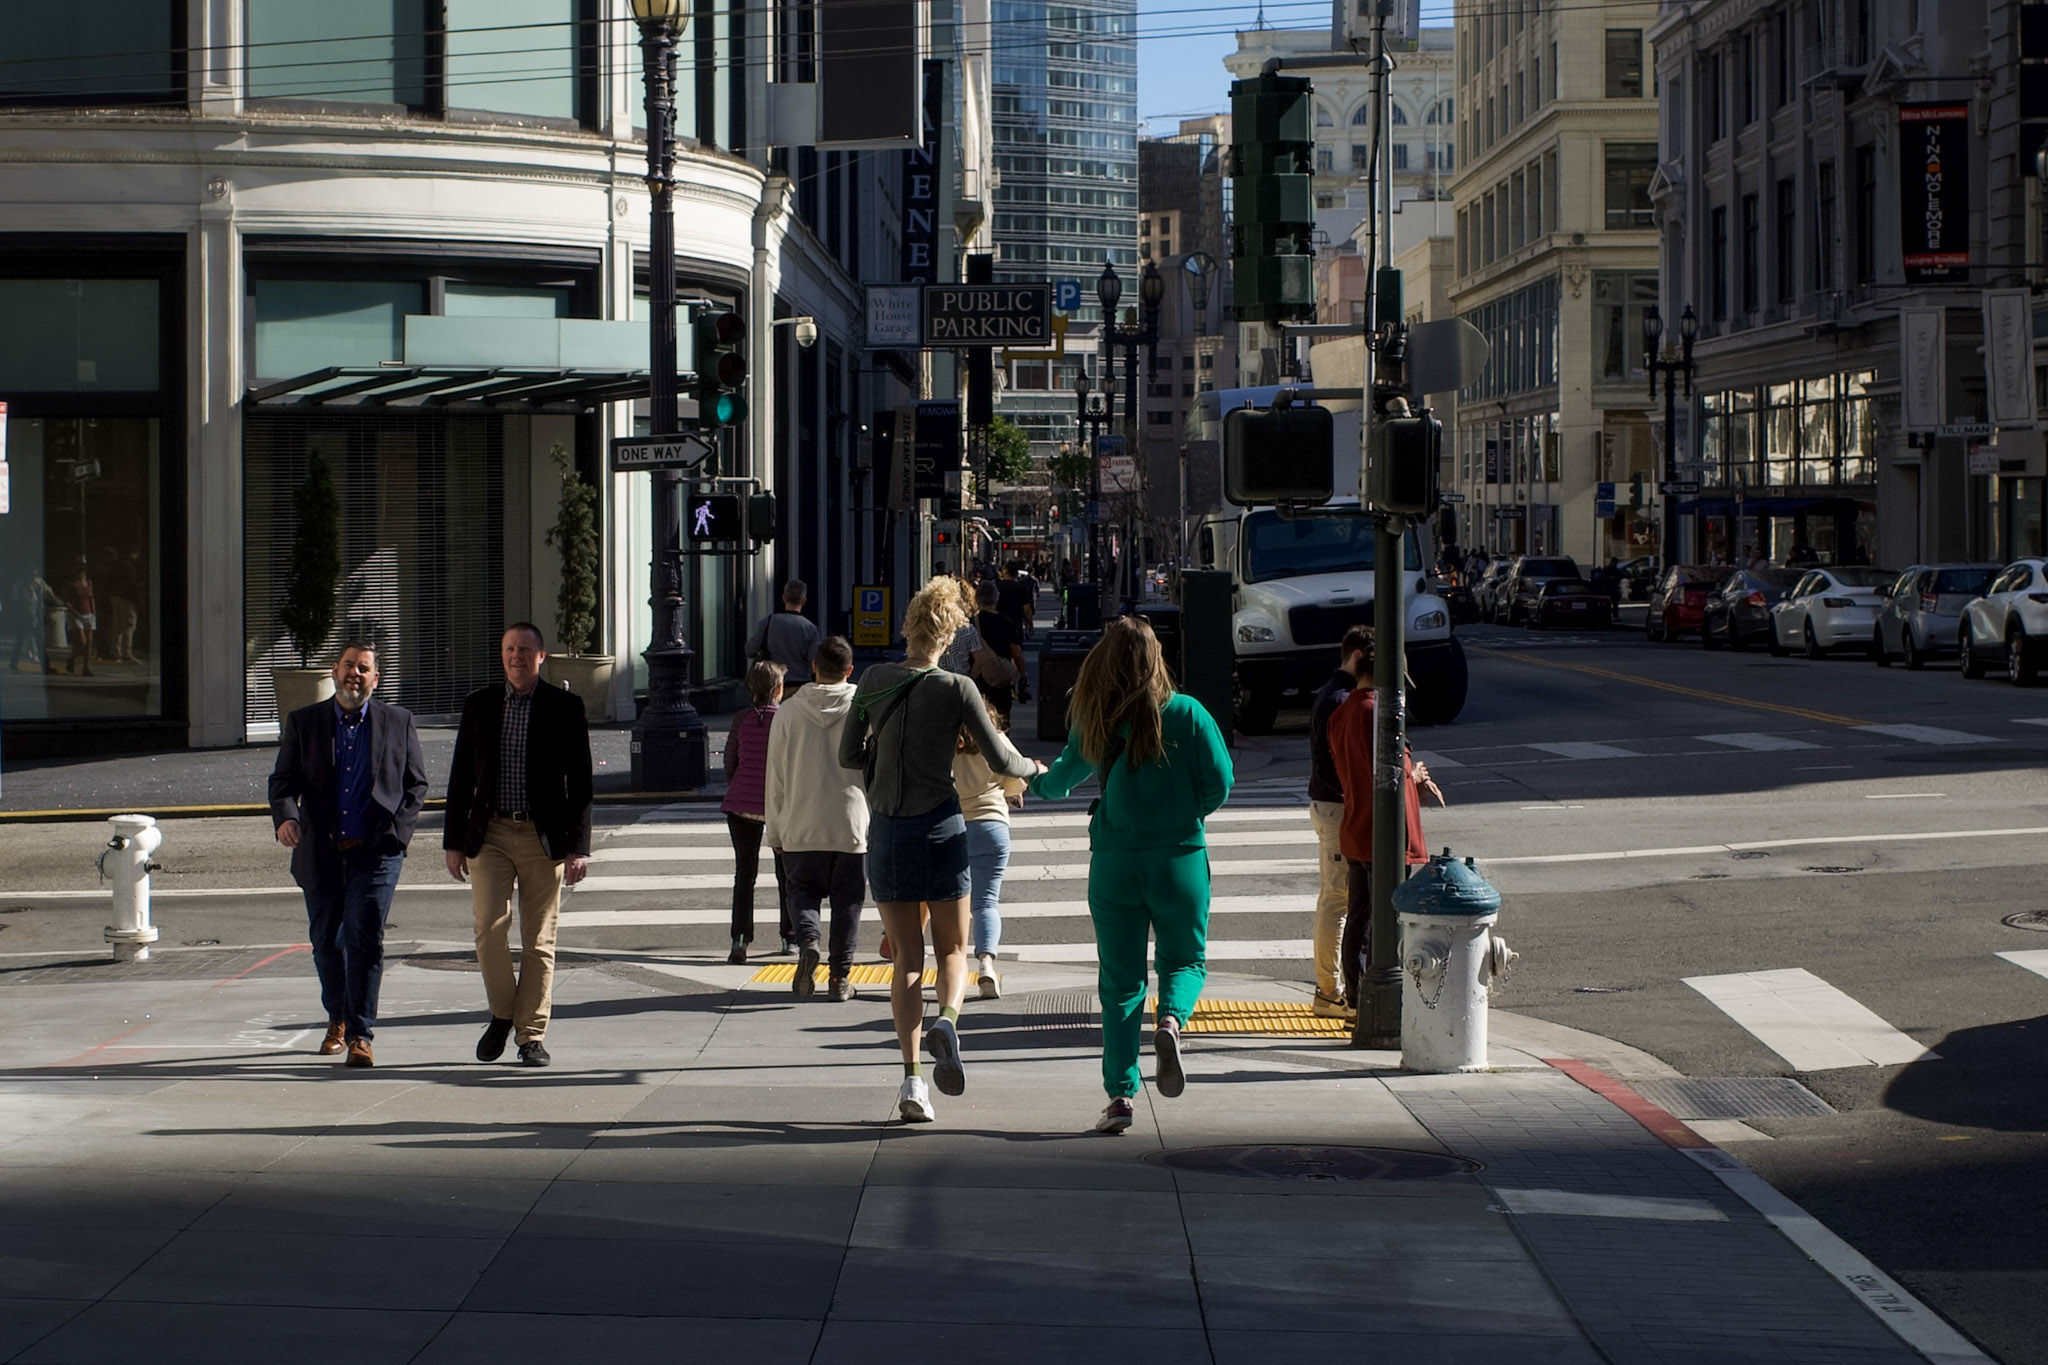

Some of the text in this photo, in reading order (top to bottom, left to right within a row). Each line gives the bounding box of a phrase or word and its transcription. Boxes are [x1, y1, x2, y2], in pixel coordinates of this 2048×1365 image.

[1926, 125, 1940, 163] NINA
[873, 298, 913, 309] White
[941, 291, 1033, 311] PUBLIC
[1059, 284, 1075, 307] P
[875, 311, 913, 320] House
[874, 323, 914, 336] Garage
[932, 316, 1042, 337] PARKING
[920, 408, 956, 416] RIMOWA
[1941, 425, 1989, 434] TILLMAN
[621, 446, 681, 461] ONE WAY
[1487, 449, 1496, 475] FENDI
[866, 591, 880, 611] P
